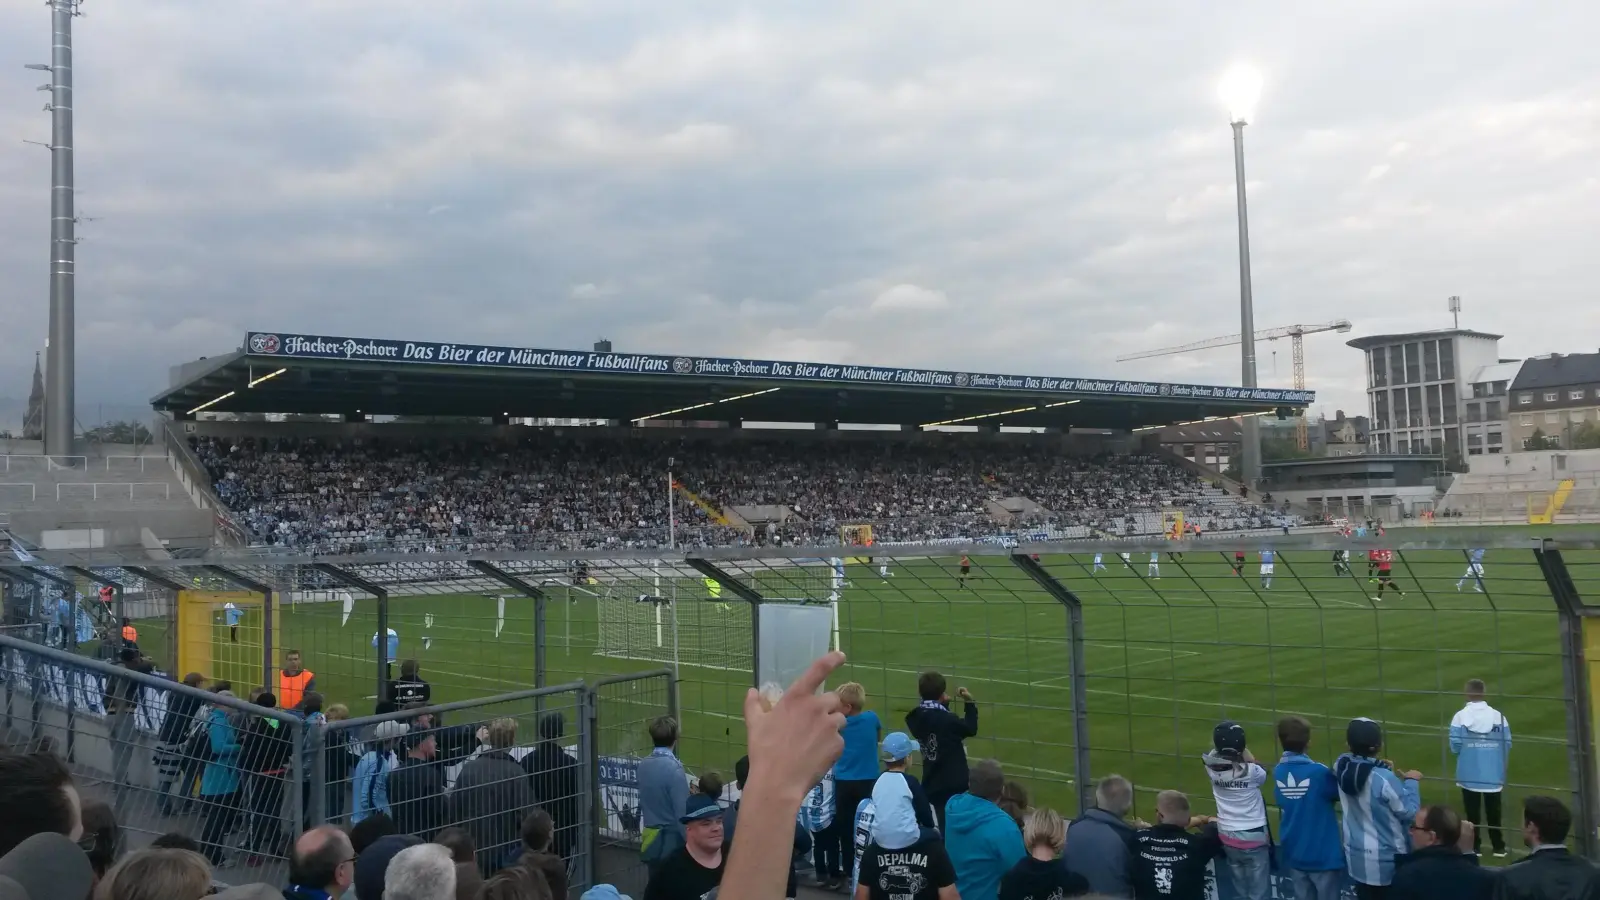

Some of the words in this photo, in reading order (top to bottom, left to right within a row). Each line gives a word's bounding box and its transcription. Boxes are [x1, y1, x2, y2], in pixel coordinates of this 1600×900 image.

[285, 336, 399, 360] Hacker-Pschorr
[403, 343, 433, 359] Das
[438, 345, 473, 362] Bier
[476, 348, 505, 364] der
[508, 349, 584, 367] Münchner
[587, 353, 669, 372] Fußballfans
[695, 359, 769, 376] Hacker-Pschorr
[771, 362, 792, 376] Das
[795, 363, 818, 377] Bier
[819, 364, 840, 378] der
[841, 366, 894, 381] Münchner
[895, 370, 952, 385] Fußballfans
[1024, 377, 1040, 388] Das
[1041, 378, 1057, 389] Bier
[1060, 379, 1073, 390] der
[1075, 379, 1114, 392] Münchner
[1114, 381, 1158, 395] Fußballfans
[1212, 388, 1225, 397] Das
[1225, 388, 1239, 398] Bier
[1239, 389, 1251, 399] der
[1214, 779, 1249, 789] MÜNCHEN
[877, 852, 928, 868] DEPALMA
[1140, 851, 1178, 862] LERCHENFELD
